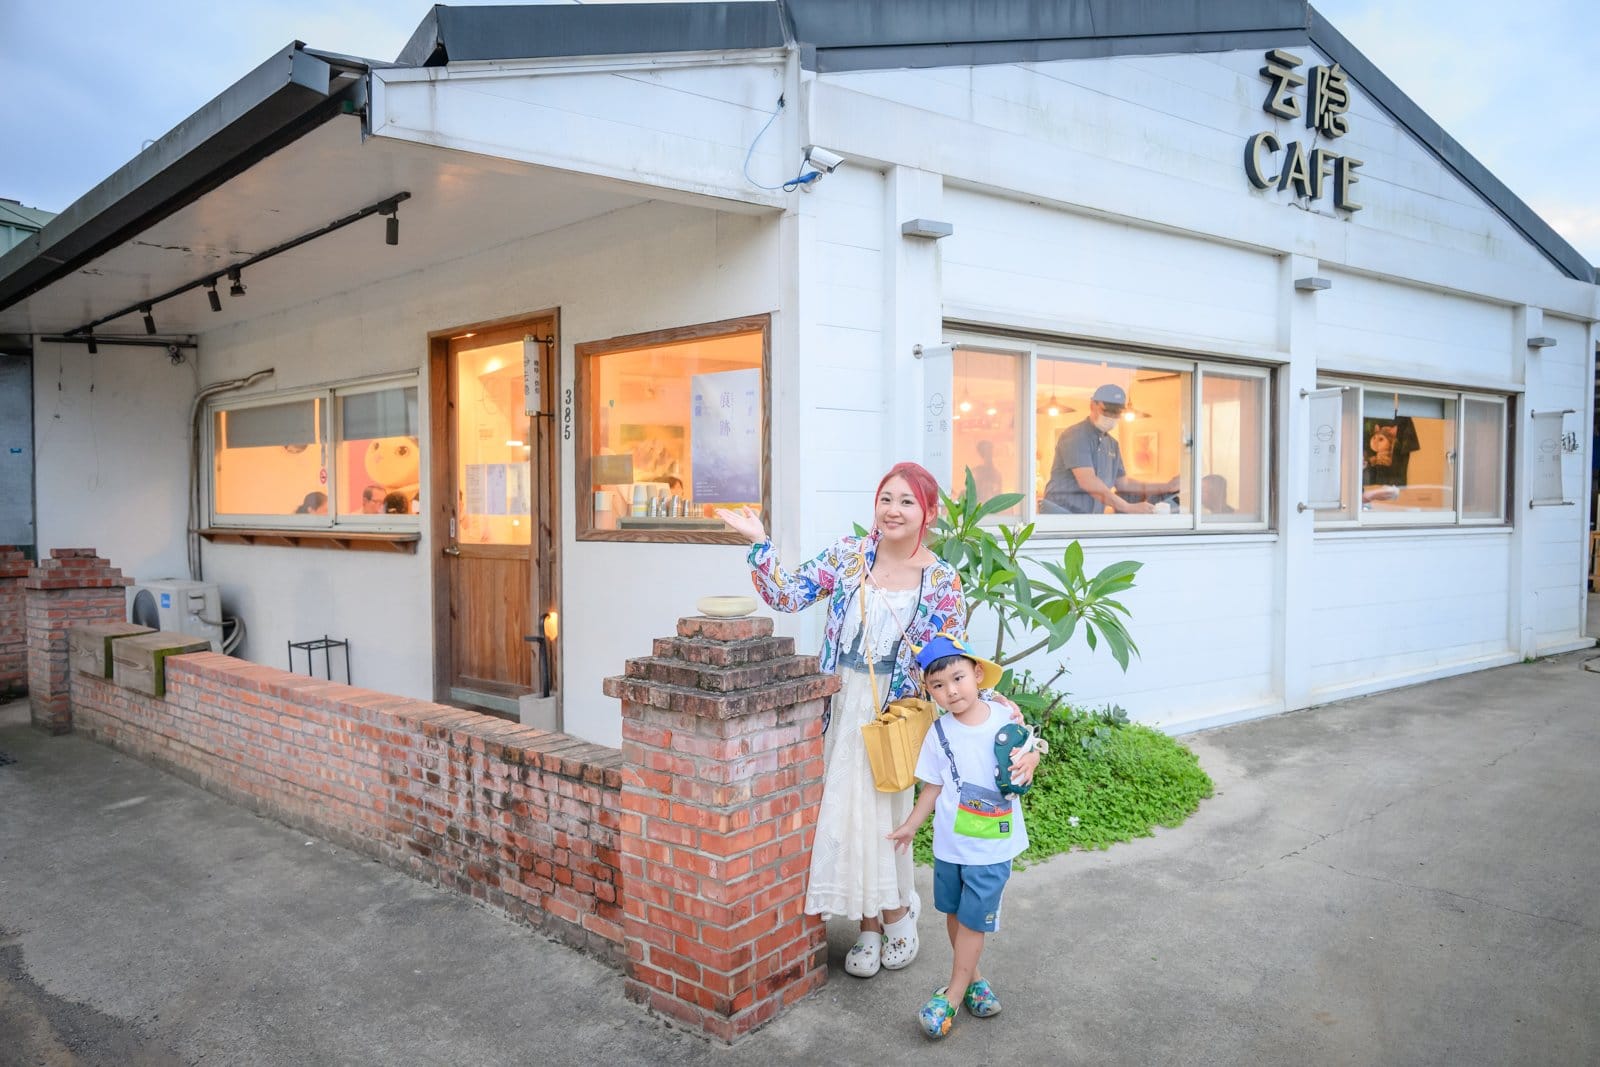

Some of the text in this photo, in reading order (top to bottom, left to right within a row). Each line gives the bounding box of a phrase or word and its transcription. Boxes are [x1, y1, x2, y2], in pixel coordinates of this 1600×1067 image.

[1259, 48, 1351, 139] 云隐
[1244, 131, 1364, 212] CAFE
[564, 389, 572, 440] 385
